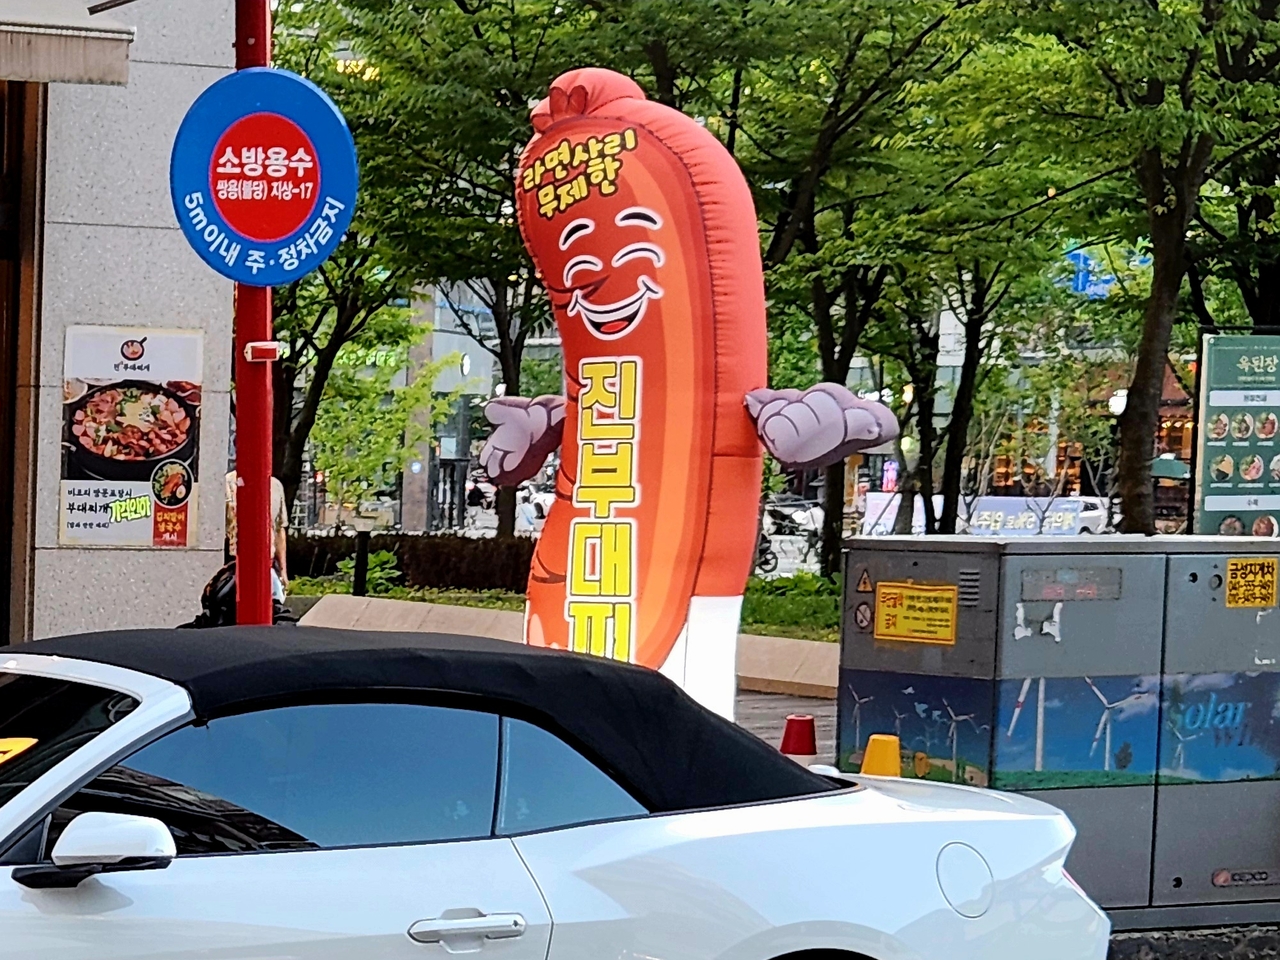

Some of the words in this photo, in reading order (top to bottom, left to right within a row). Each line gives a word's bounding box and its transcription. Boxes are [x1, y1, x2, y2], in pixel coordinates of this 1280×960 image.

[216, 146, 314, 178] 소방용수
[523, 129, 637, 190] 라면사리
[270, 181, 314, 200] 지상-17
[538, 156, 621, 218] 무제한
[184, 192, 241, 267] 5m이내
[1229, 562, 1275, 580] 금성지게차
